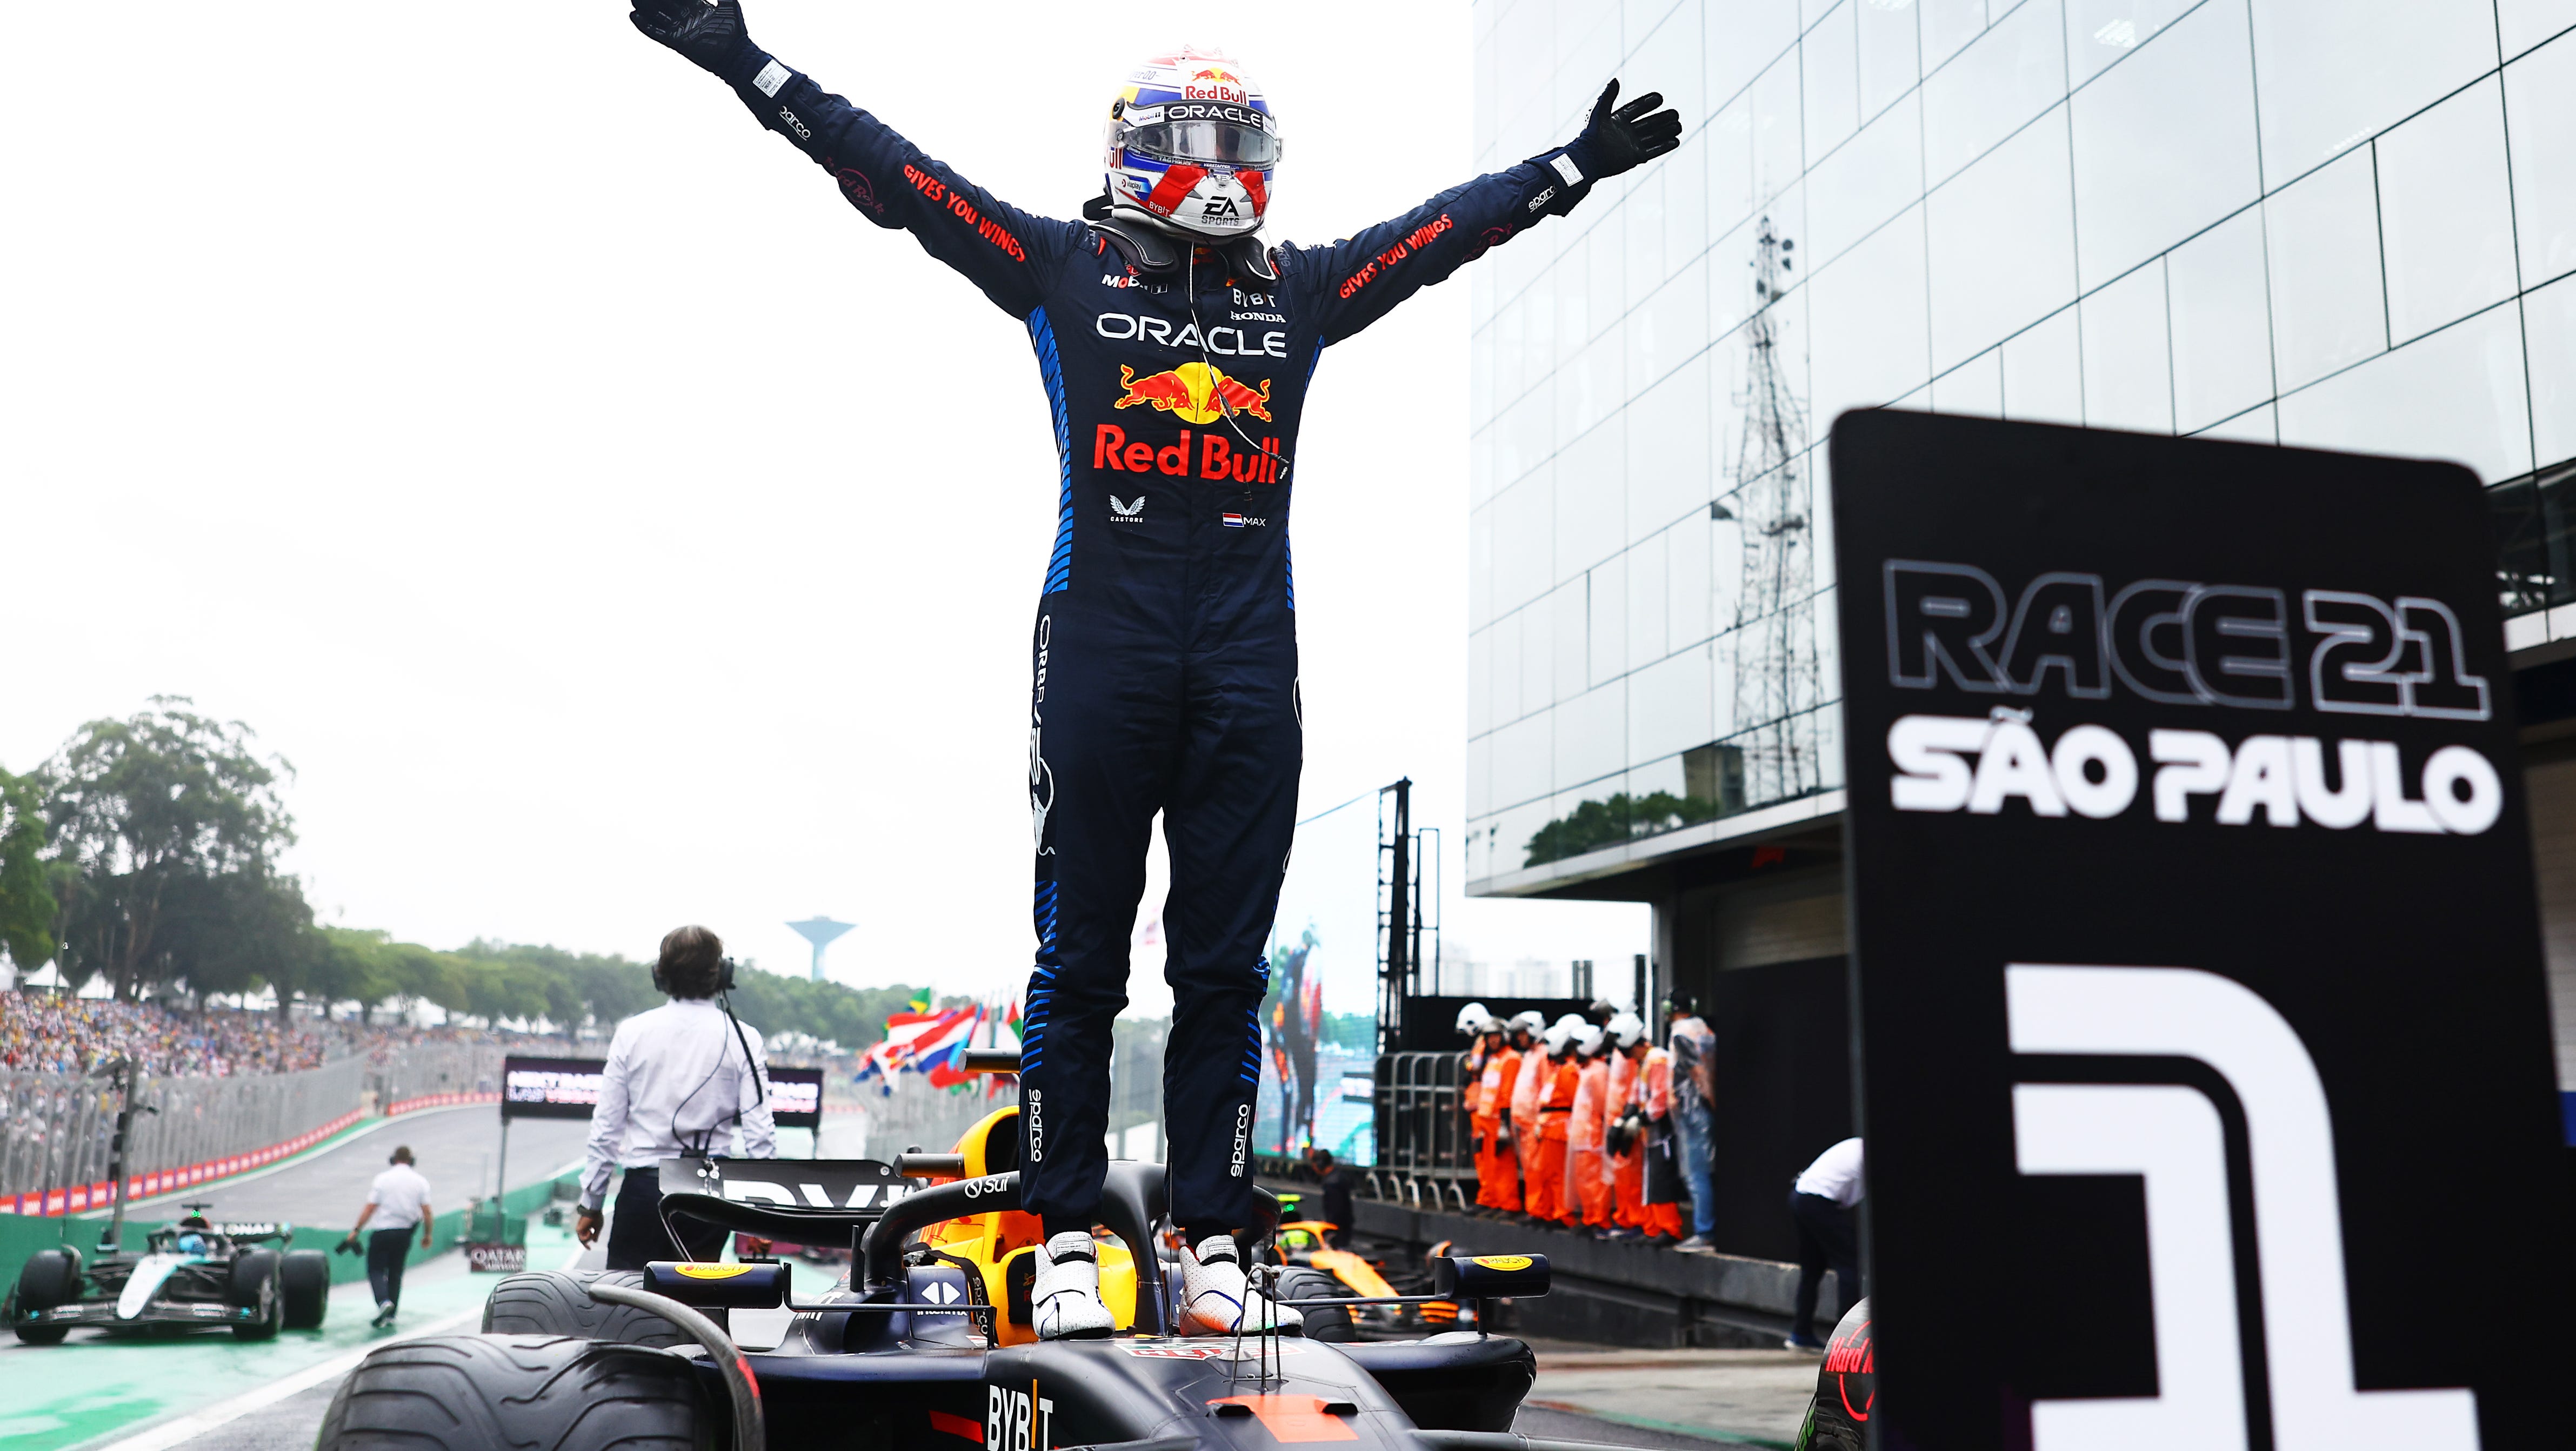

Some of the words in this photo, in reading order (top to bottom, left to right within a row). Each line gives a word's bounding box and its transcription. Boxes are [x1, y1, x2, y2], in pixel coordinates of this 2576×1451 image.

[1186, 85, 1217, 99] Red
[1220, 86, 1247, 105] Bull
[1168, 105, 1261, 128] ORACLE
[1109, 146, 1123, 170] ull
[904, 164, 947, 202] GIVES
[946, 191, 978, 225] YOU
[1149, 201, 1170, 217] BYBIT
[1203, 196, 1239, 217] EA
[1529, 183, 1559, 213] sparc
[1201, 215, 1240, 226] SPORTS
[1339, 262, 1377, 299] GIVES
[1377, 242, 1408, 270] YOU
[1405, 213, 1453, 250] WINGS
[1102, 274, 1148, 291] Mob
[1230, 310, 1286, 323] HONDA
[1096, 312, 1287, 358] ORACLE
[1093, 424, 1191, 477] Red
[1200, 434, 1279, 484] Bull
[1243, 517, 1266, 527] MAX
[1882, 558, 2294, 711] RACE
[2303, 589, 2492, 721] 21
[1887, 706, 2139, 819] SÃO
[2149, 728, 2504, 835] PAULO
[1029, 1088, 1043, 1162] sparco
[1230, 1104, 1251, 1177] sparco
[984, 1175, 1010, 1193] Sui
[2004, 962, 2482, 1451] 1
[1826, 1336, 1870, 1373] Hard
[987, 1379, 1053, 1451] BYBIT
